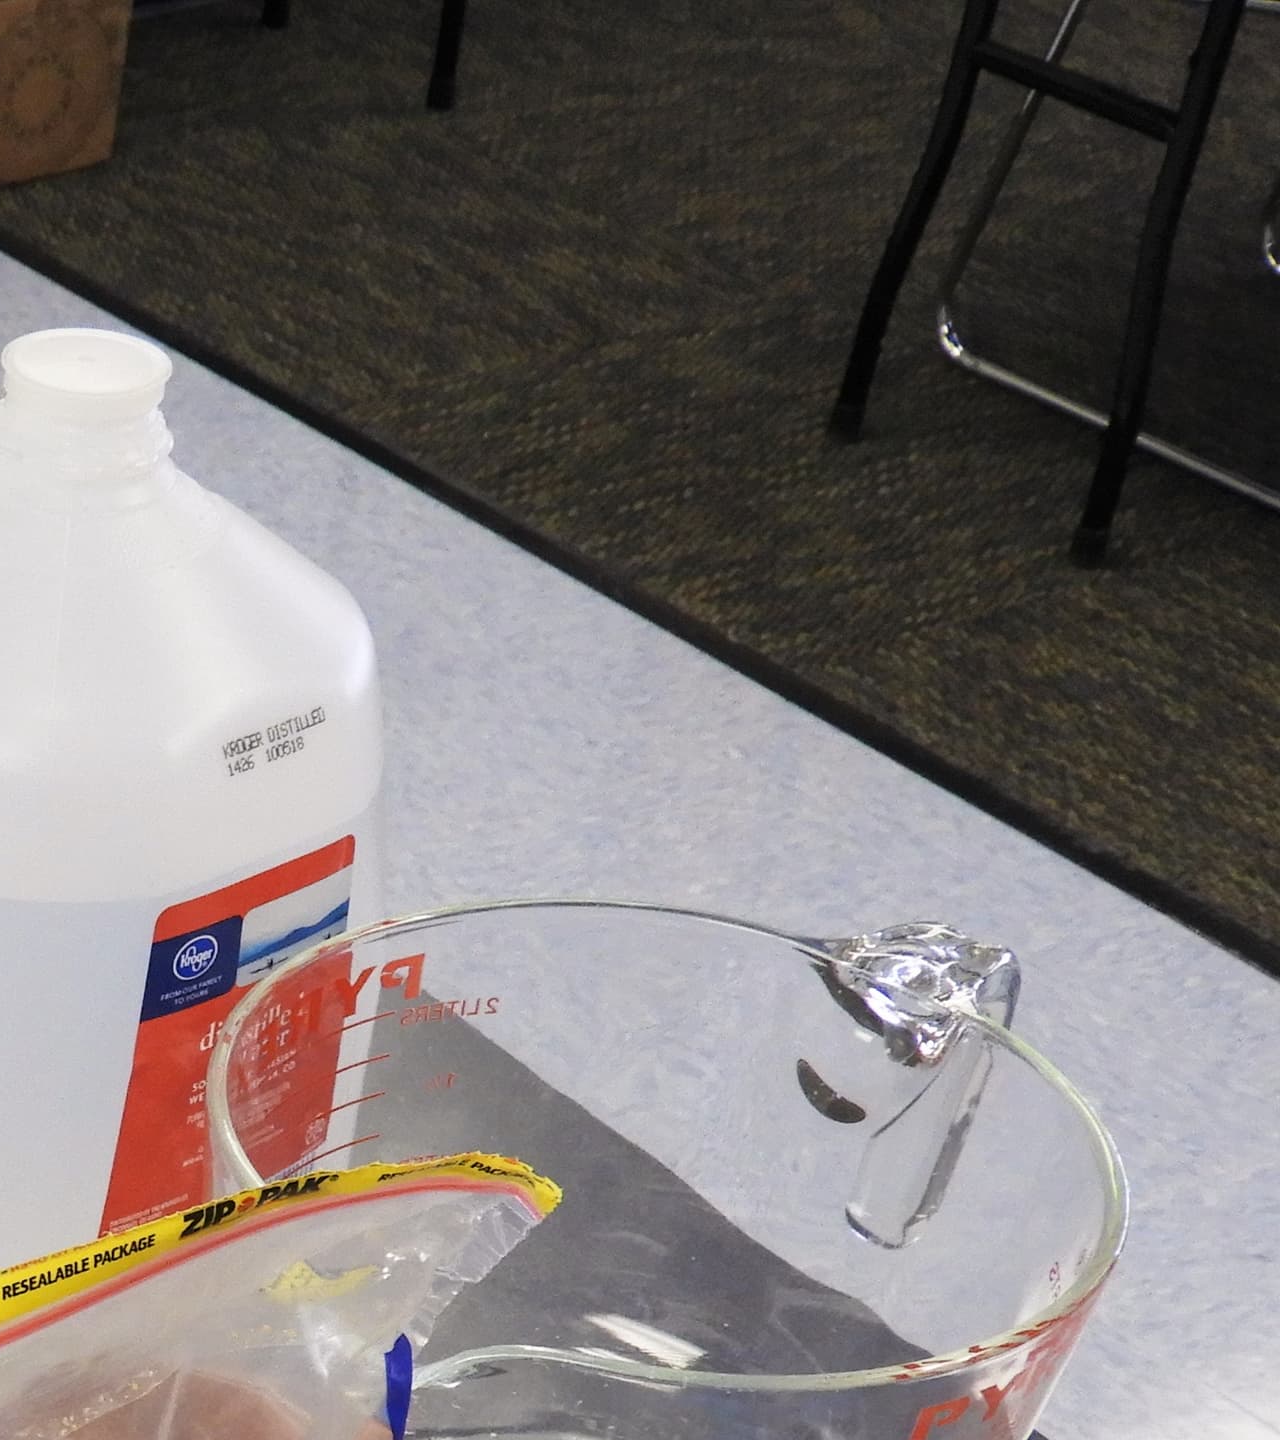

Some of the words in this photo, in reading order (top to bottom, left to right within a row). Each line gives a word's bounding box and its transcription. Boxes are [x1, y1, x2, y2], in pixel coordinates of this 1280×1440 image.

[267, 706, 326, 743] DISTILLED
[179, 945, 214, 972] Kroger
[179, 1199, 236, 1240] ZIP
[256, 1174, 329, 1208] PAK
[1, 1257, 90, 1300] RESEALABLE
[93, 1234, 156, 1268] PACKAGE
